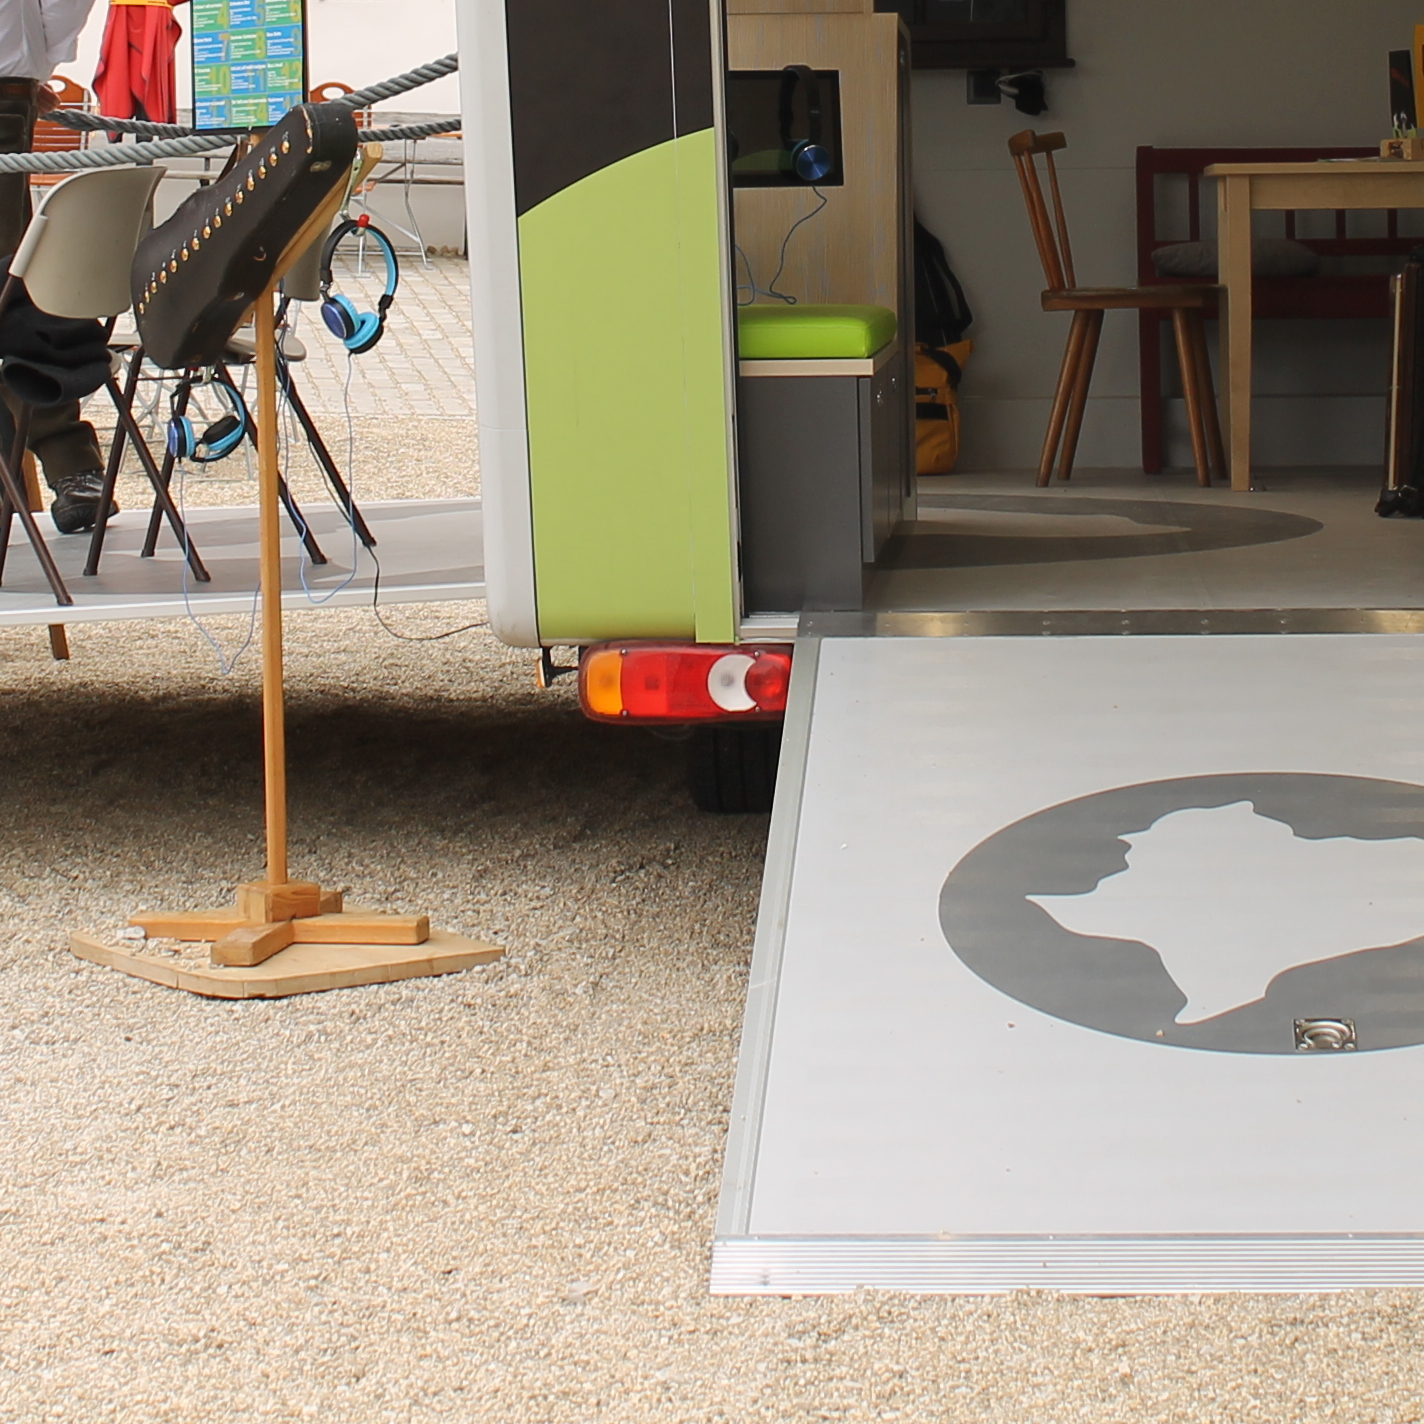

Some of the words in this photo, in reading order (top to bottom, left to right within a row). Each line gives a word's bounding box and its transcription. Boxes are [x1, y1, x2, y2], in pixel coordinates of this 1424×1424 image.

[217, 0, 228, 29] 4
[219, 33, 230, 61] 7
[256, 31, 266, 59] 8
[292, 29, 302, 55] 9
[209, 65, 230, 95] 10
[246, 64, 265, 93] 11
[281, 61, 302, 90] 12
[248, 97, 267, 125] 14
